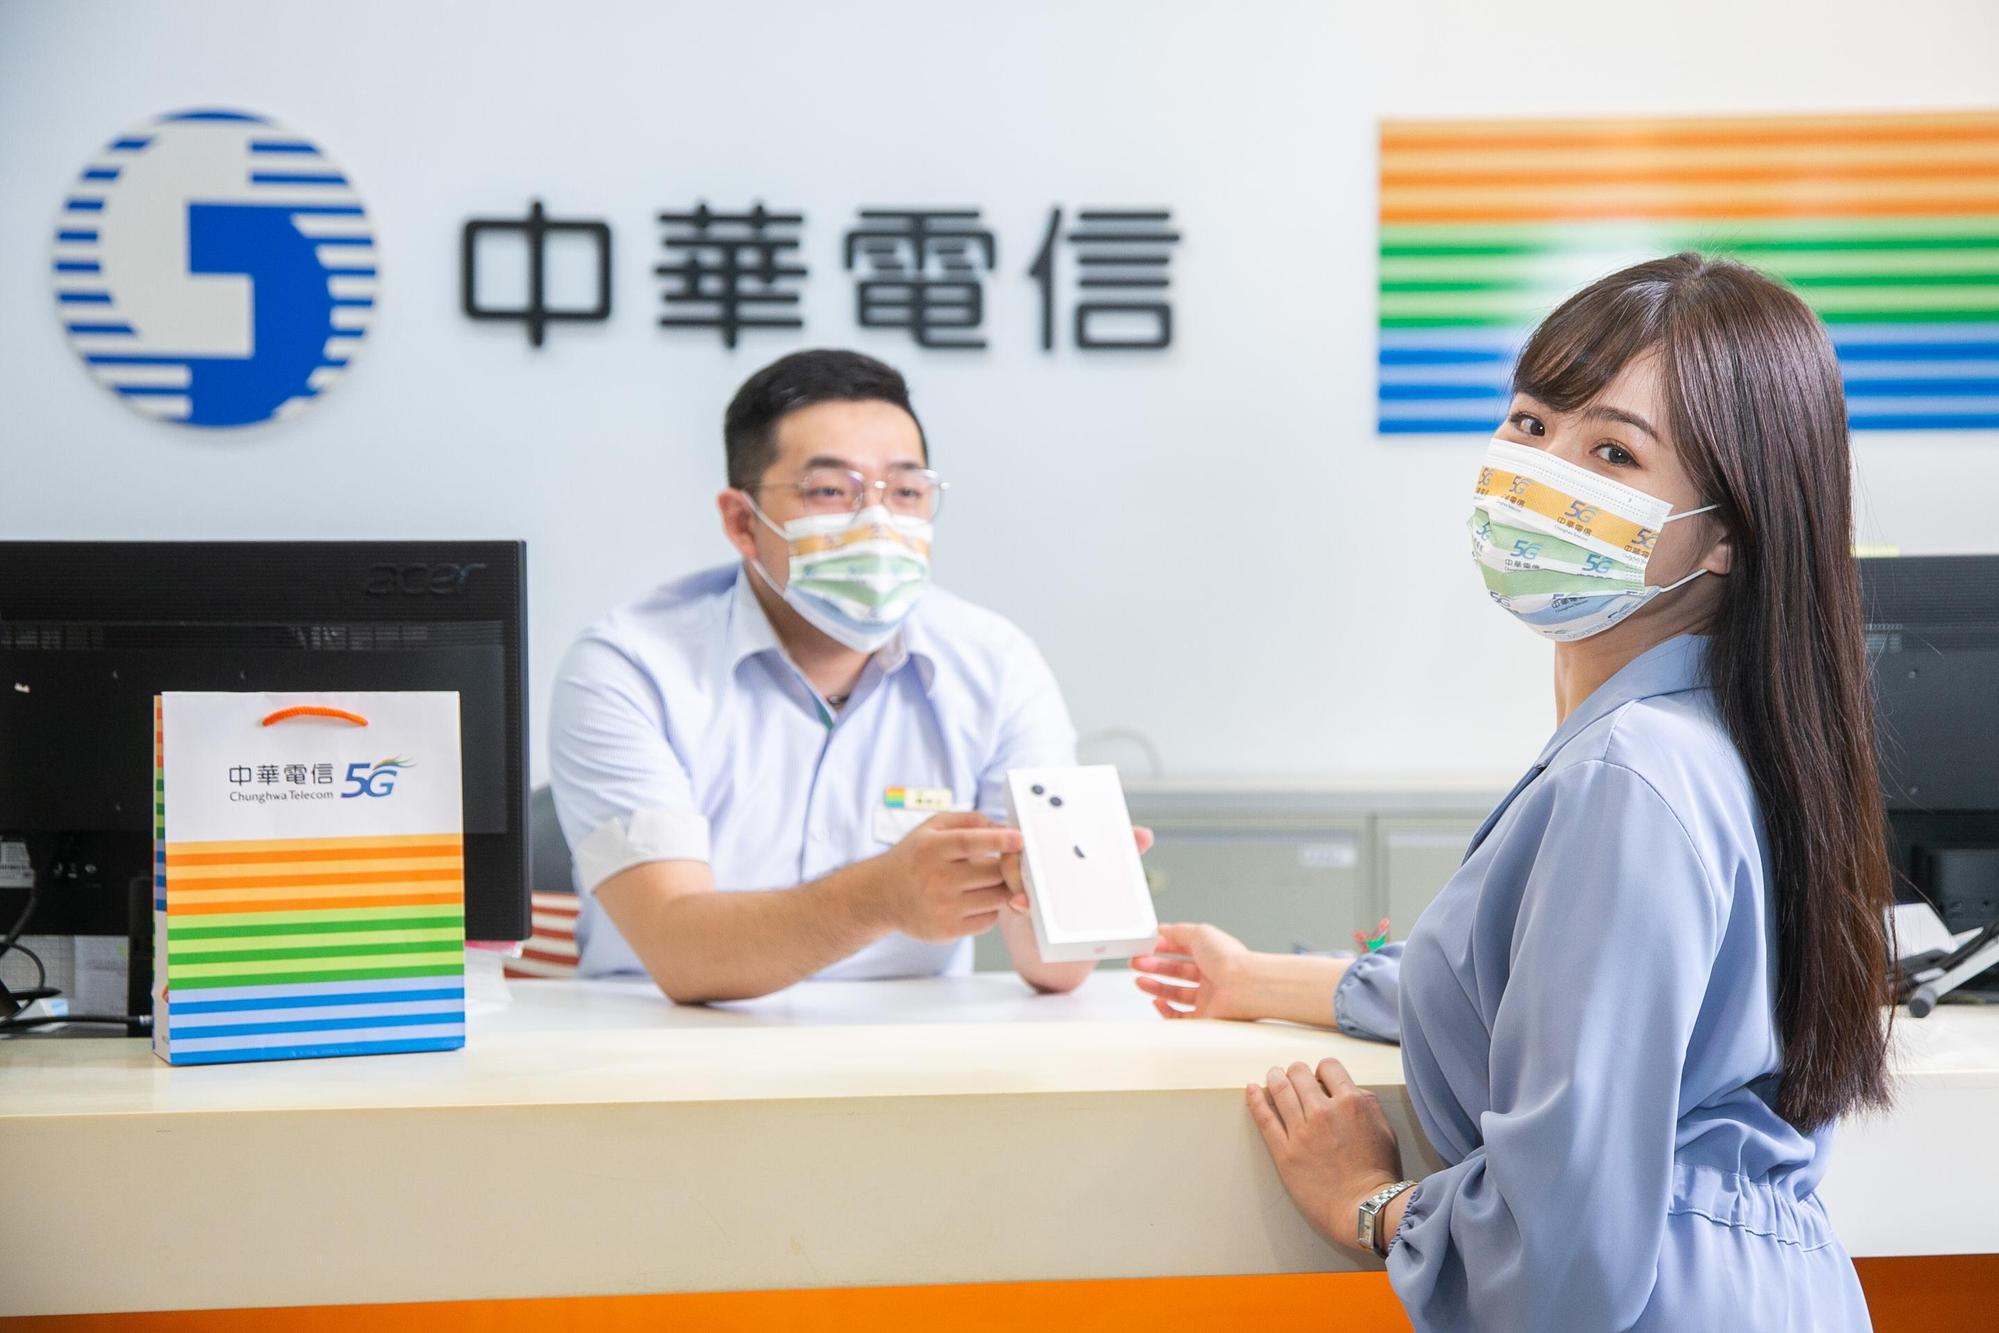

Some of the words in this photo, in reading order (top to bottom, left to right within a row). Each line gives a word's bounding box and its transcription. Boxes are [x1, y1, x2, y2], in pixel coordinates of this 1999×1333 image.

[462, 199, 1181, 351] 中華電信
[1509, 475, 1531, 496] 5G
[1564, 500, 1596, 523] 5G
[1510, 540, 1541, 560] 5G
[1582, 553, 1613, 574] 5G
[365, 562, 487, 594] acer
[229, 763, 334, 786] 中華電信
[341, 759, 399, 799] 5G
[230, 790, 288, 805] Chunghwa
[289, 788, 334, 801] Telecom
